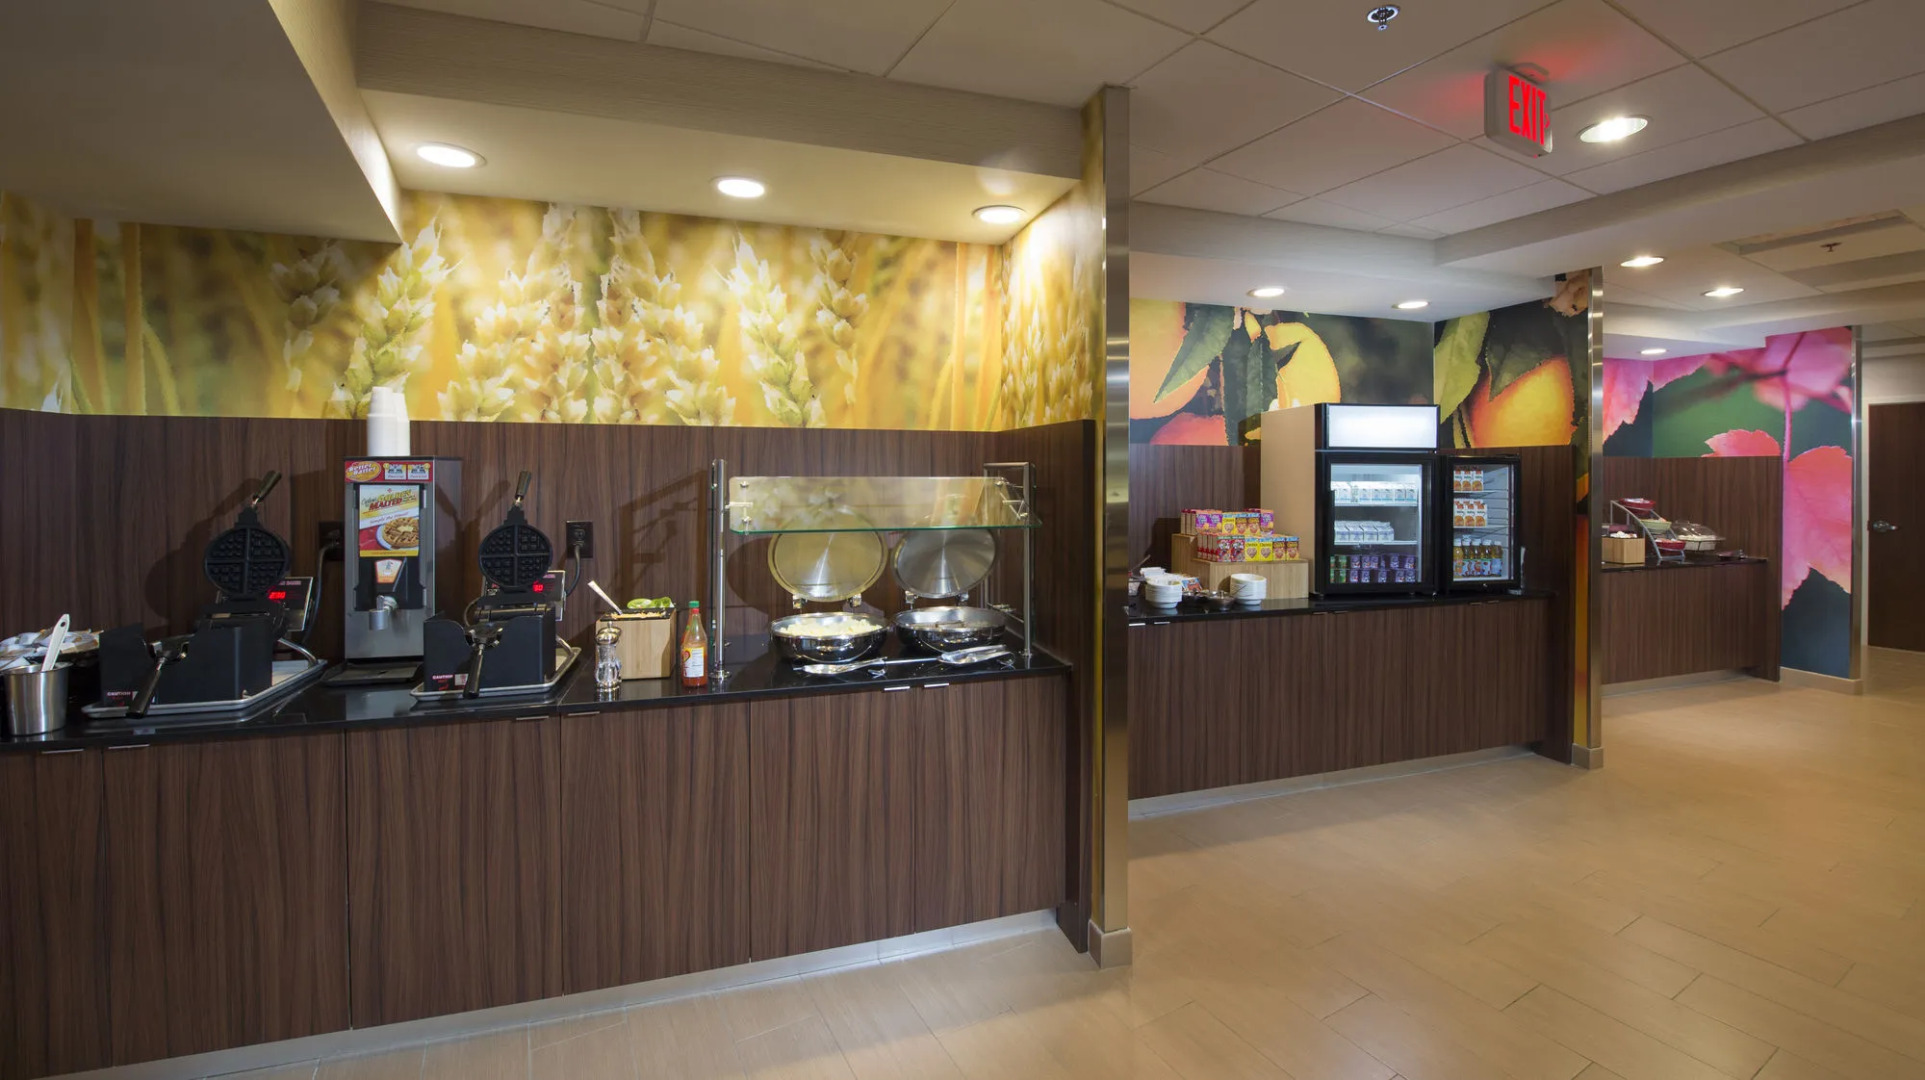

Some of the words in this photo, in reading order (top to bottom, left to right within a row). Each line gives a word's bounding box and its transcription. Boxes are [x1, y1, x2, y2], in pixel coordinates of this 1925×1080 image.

[1509, 74, 1546, 145] EXIT
[377, 489, 412, 501] GOLDEN
[369, 497, 403, 510] MALTED
